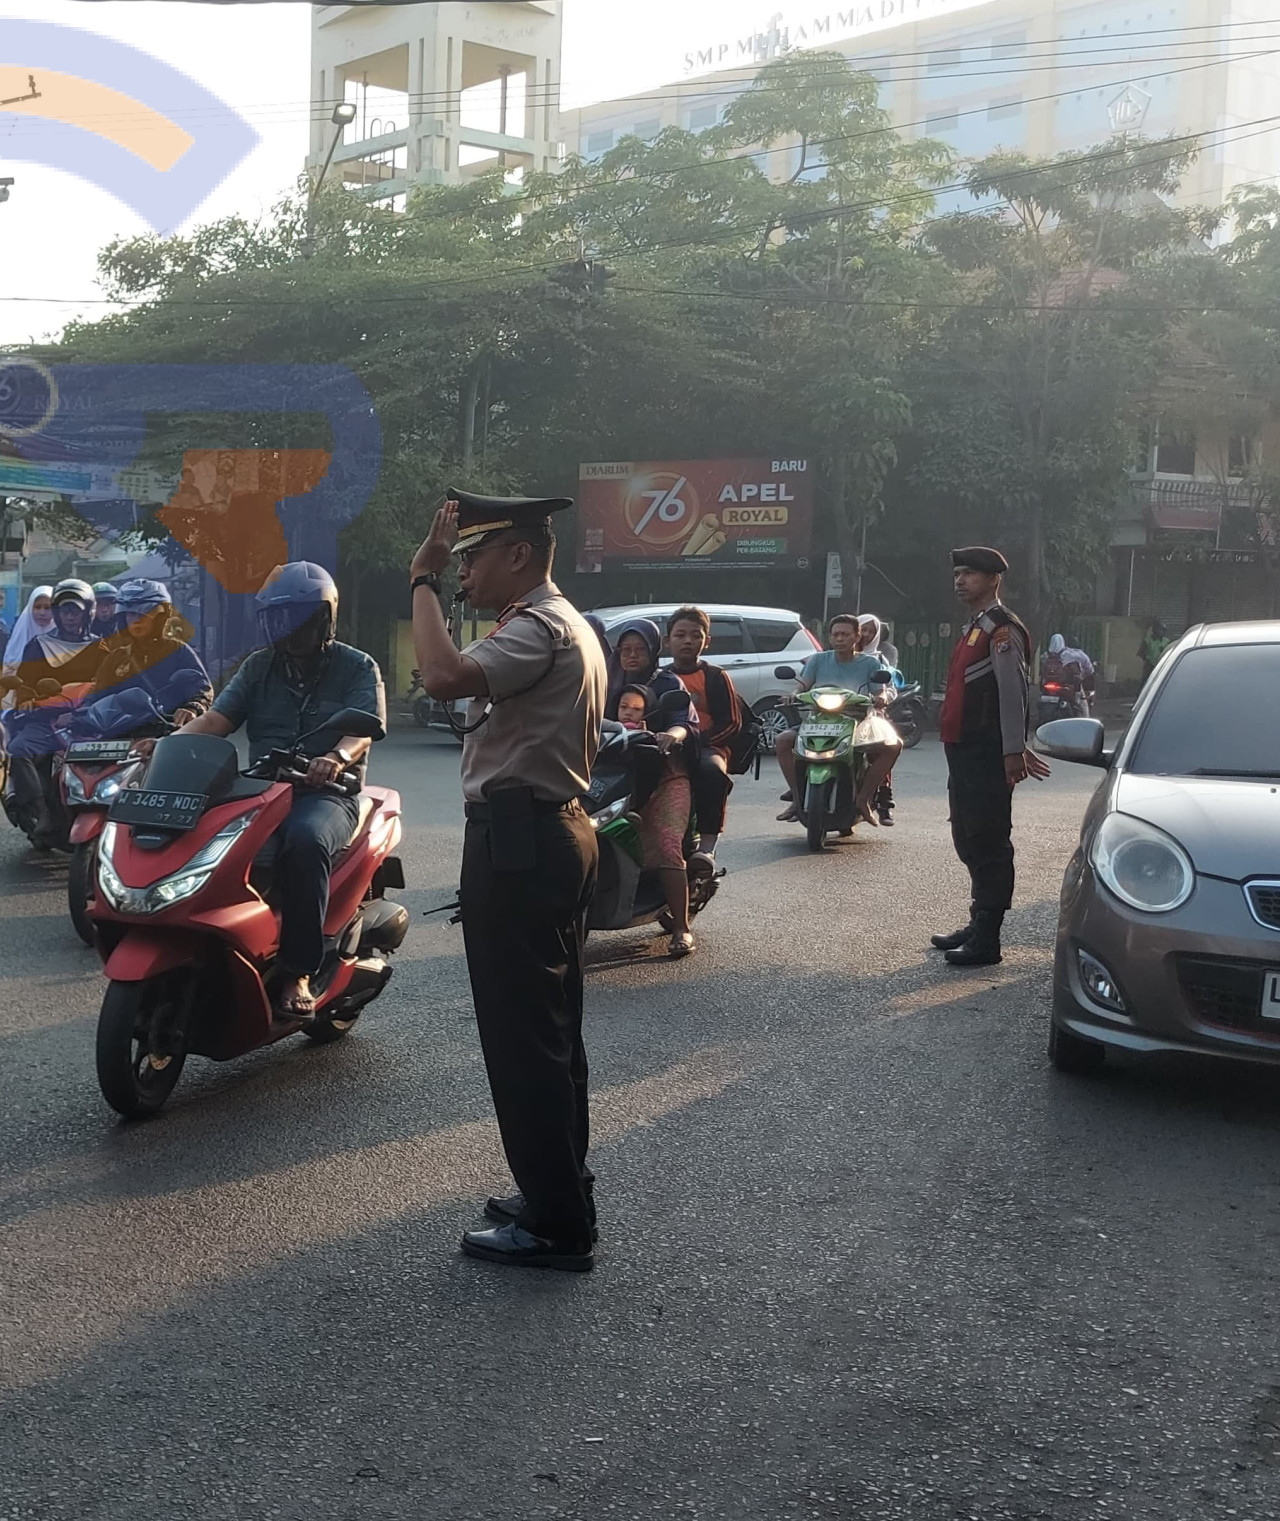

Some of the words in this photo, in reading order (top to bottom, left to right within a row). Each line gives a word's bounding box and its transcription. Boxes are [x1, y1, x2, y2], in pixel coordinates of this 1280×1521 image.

[682, 43, 729, 72] SMP
[771, 460, 807, 473] BARU
[718, 483, 795, 502] APEL
[632, 475, 686, 536] 76
[728, 509, 784, 523] ROYAL
[132, 793, 168, 808] 3485
